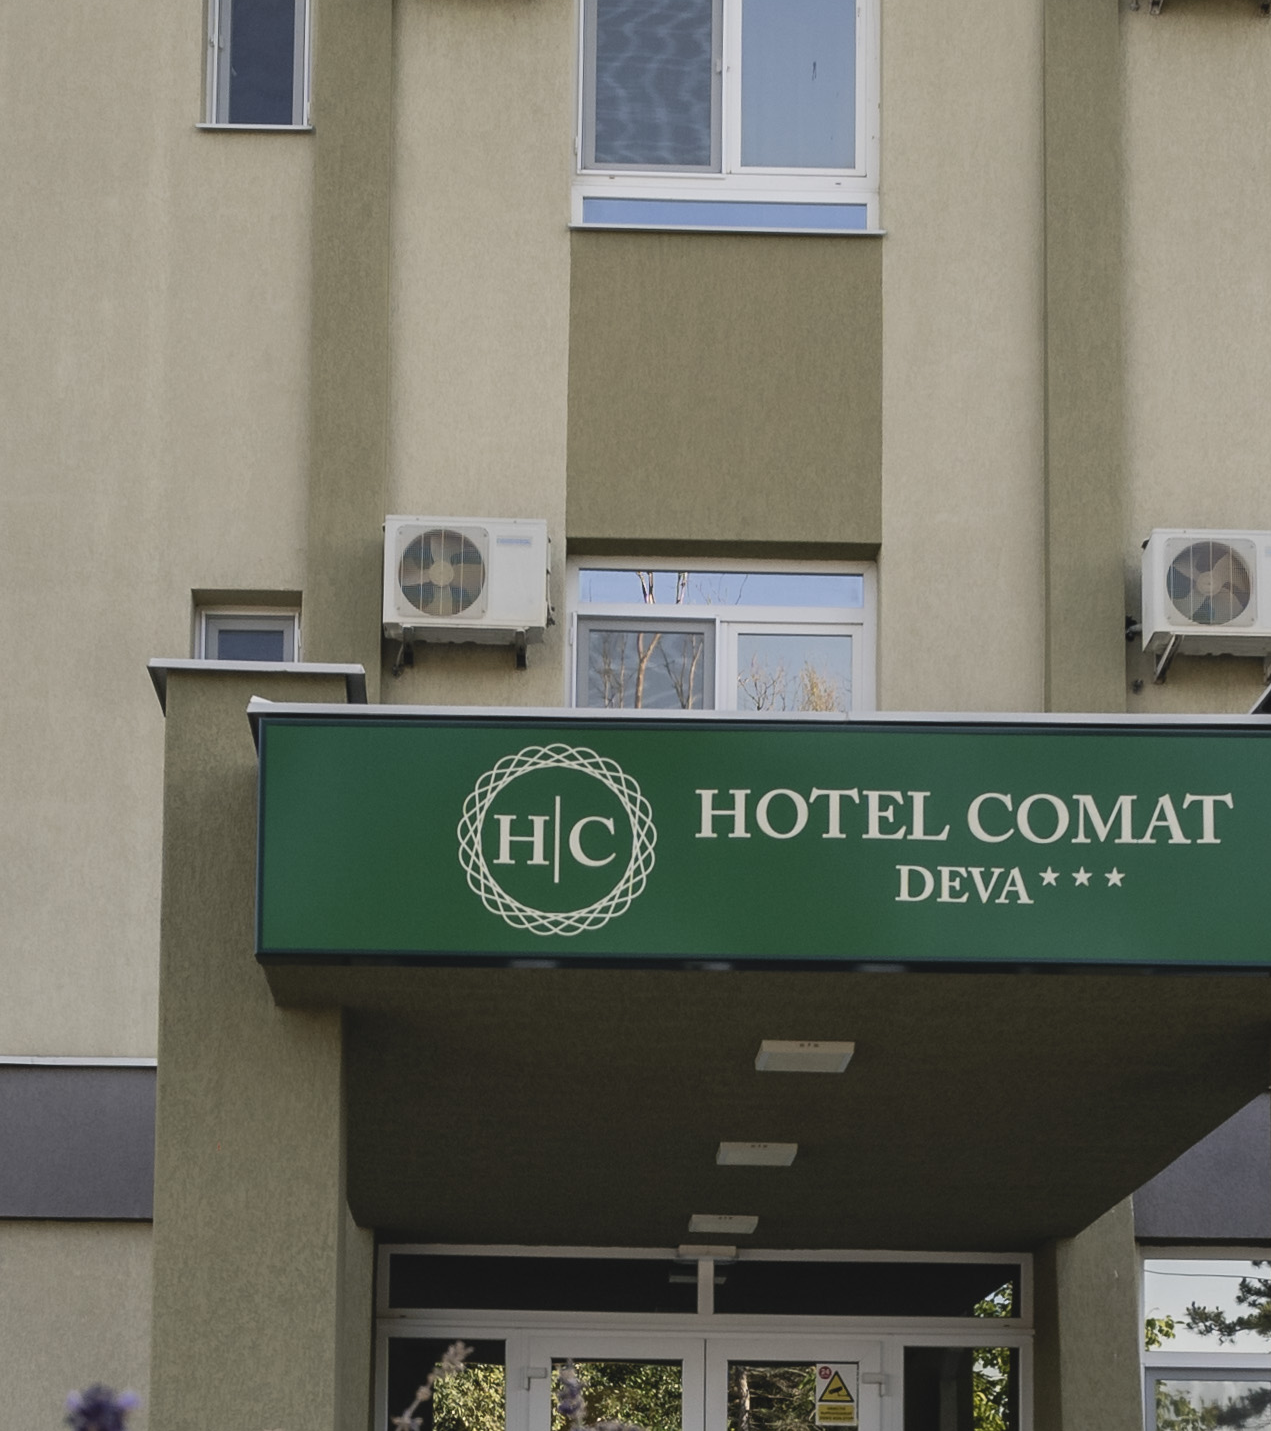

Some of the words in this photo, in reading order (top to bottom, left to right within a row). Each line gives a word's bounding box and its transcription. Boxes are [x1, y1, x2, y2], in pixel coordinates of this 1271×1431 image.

[695, 786, 950, 841] HOTEL
[967, 792, 1235, 844] COMAT
[895, 864, 1034, 905] DEVA
